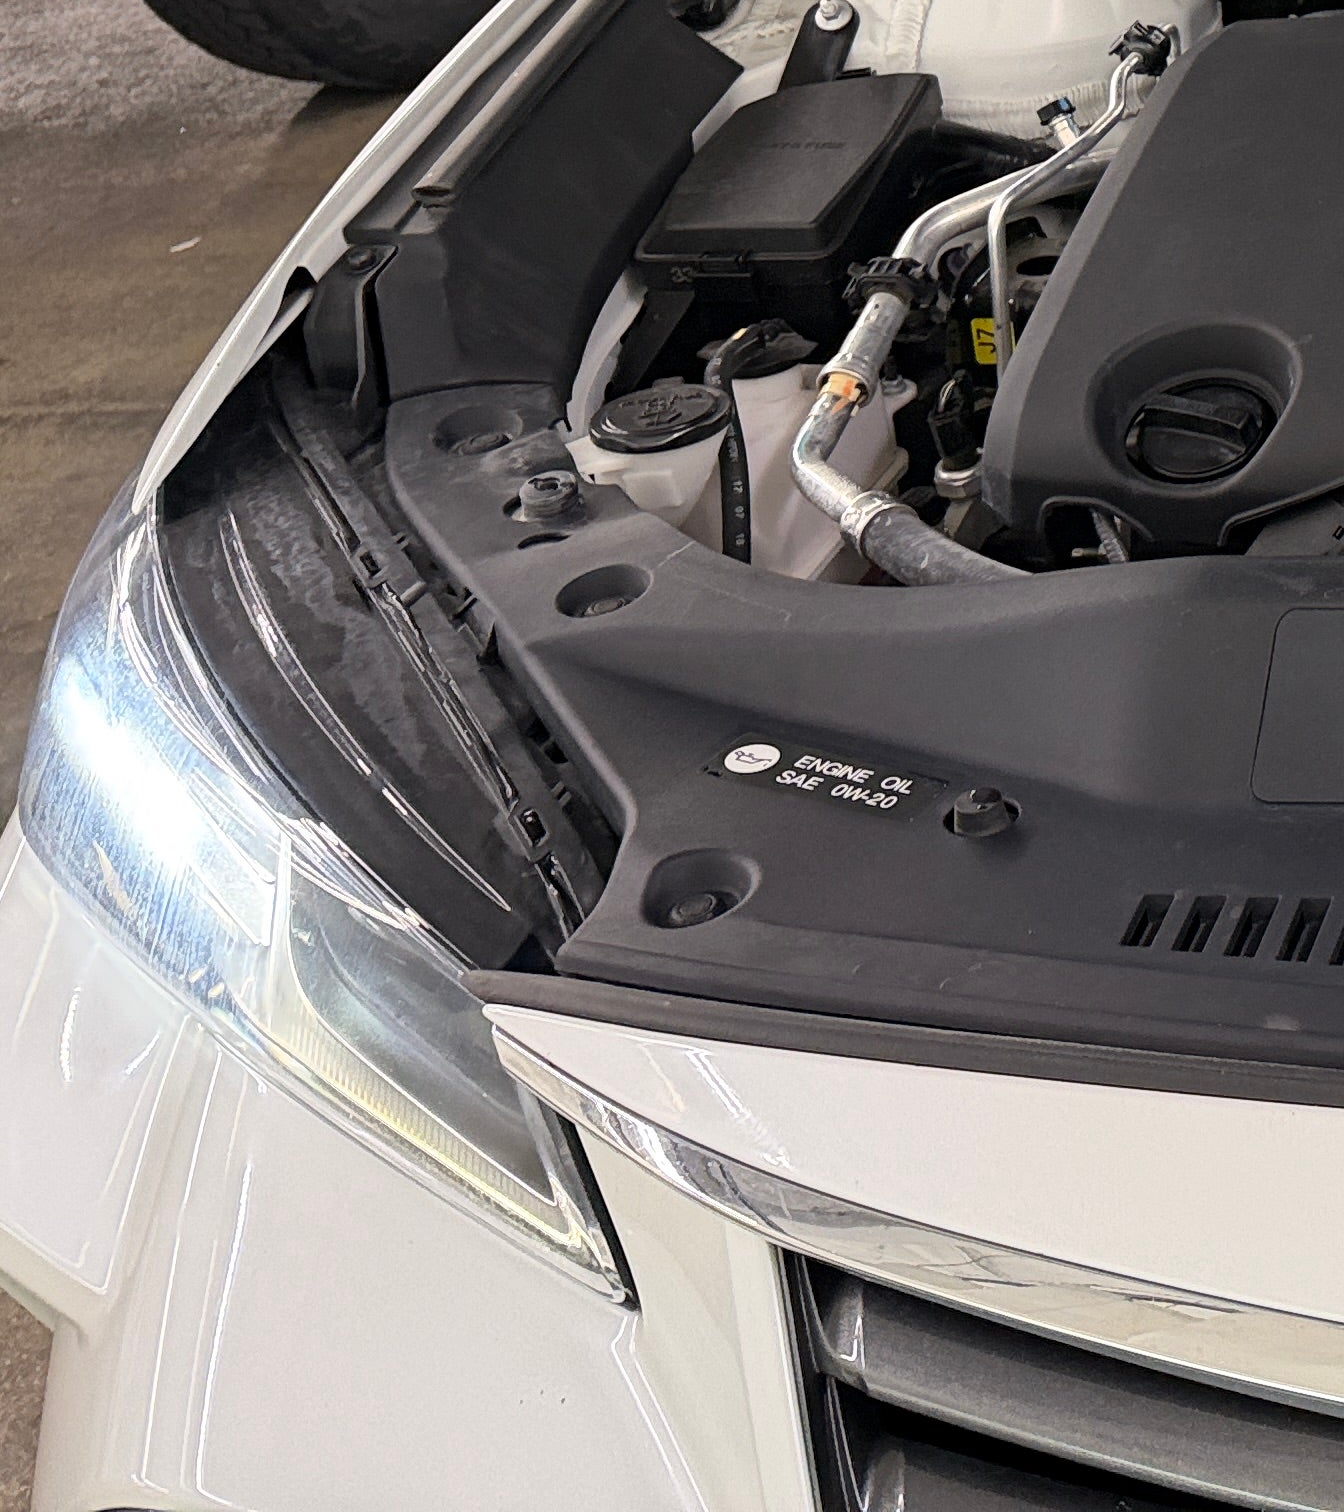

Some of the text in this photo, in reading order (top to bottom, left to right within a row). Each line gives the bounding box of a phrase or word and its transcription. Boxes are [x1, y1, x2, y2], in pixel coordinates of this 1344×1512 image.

[976, 328, 996, 354] J7
[776, 770, 898, 809] SAE 0W-20
[793, 754, 913, 794] ENGINE OIL
